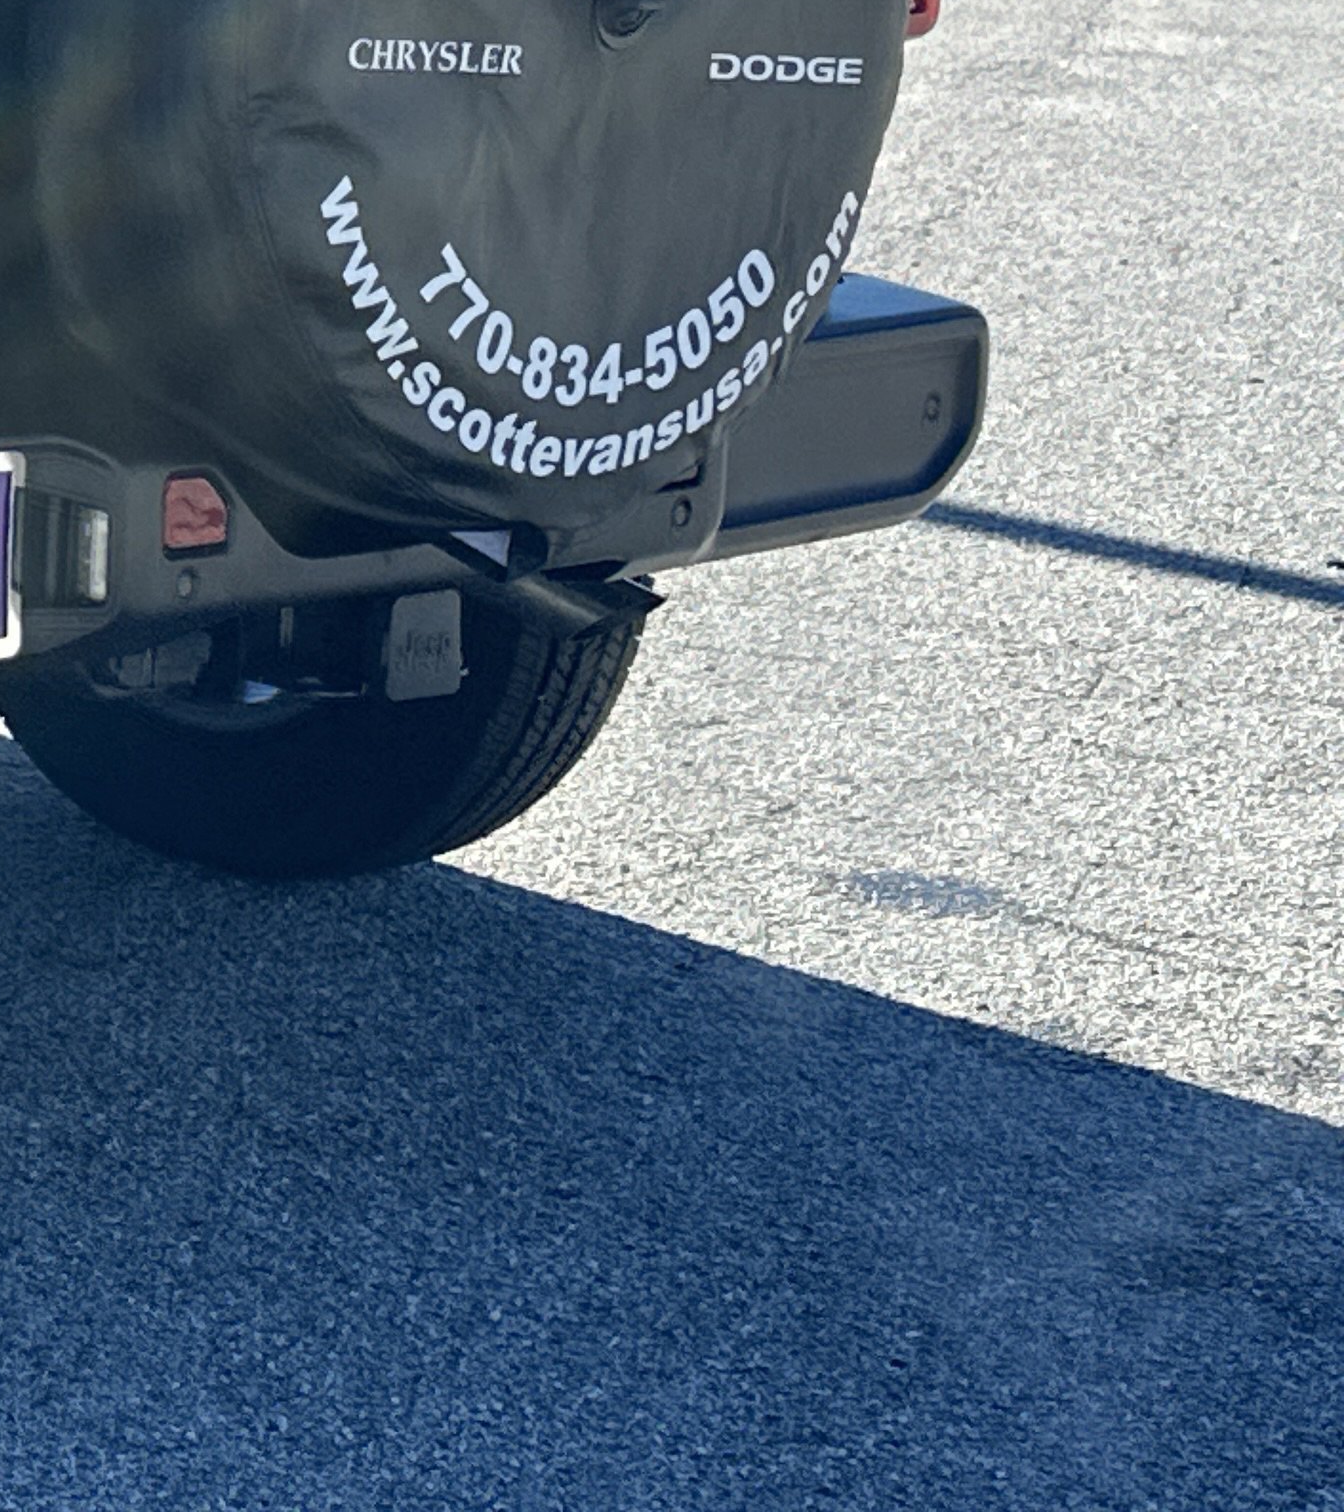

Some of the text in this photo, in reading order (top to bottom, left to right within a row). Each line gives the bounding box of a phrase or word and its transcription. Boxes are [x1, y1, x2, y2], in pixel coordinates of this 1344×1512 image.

[348, 37, 864, 84] CHRYSLER DODGE
[319, 175, 859, 478] www.scottevansusa.com
[419, 243, 777, 406] 770-834-5050
